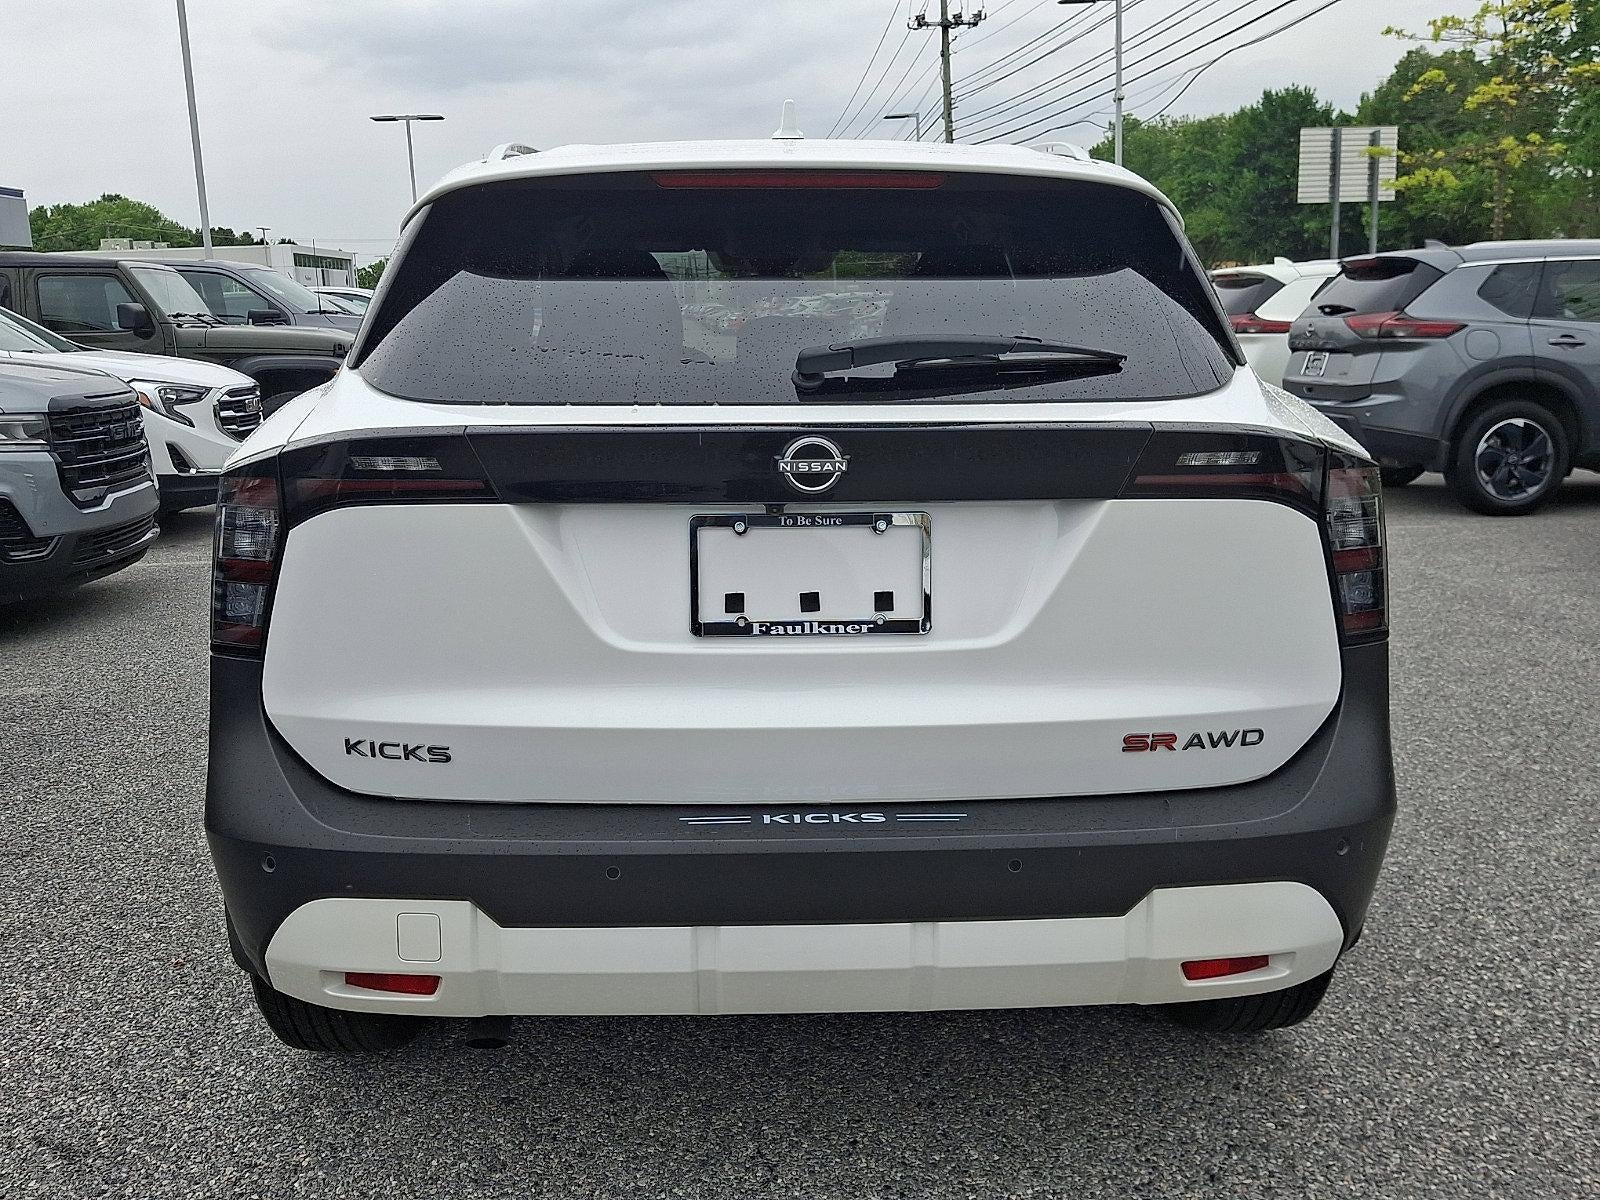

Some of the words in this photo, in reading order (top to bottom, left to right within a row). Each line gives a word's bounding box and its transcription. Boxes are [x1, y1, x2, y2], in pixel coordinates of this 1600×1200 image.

[779, 461, 846, 472] NISSAN
[778, 515, 793, 526] To
[797, 515, 812, 526] Be
[814, 515, 843, 526] Sure
[751, 621, 874, 635] Faulkner
[1122, 732, 1178, 752] SR
[1182, 727, 1265, 751] AWD
[344, 736, 452, 763] KICKS
[762, 812, 886, 824] KICKS
